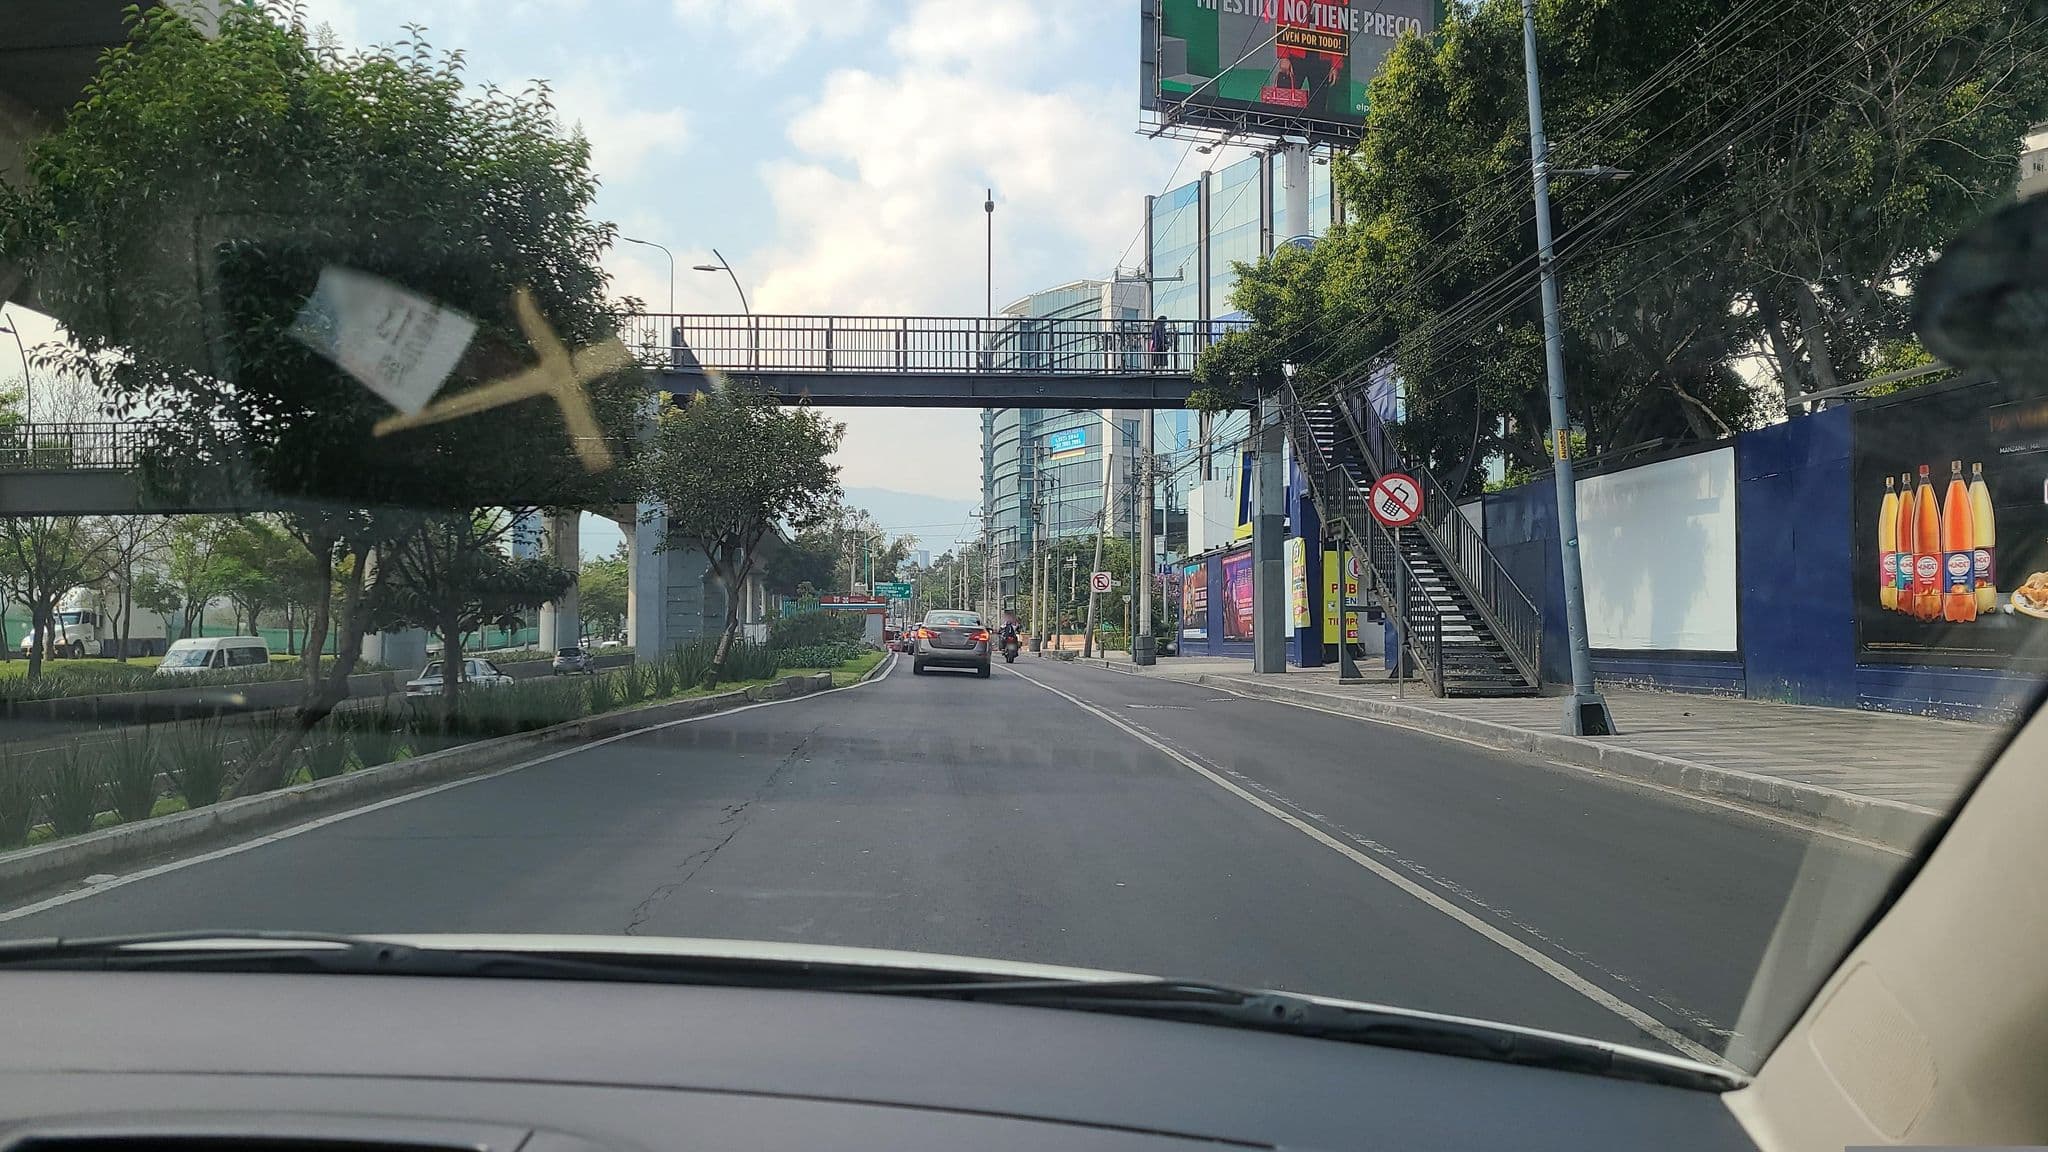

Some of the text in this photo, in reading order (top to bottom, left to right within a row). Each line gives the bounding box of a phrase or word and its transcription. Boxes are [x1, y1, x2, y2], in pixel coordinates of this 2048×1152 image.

[1283, 0, 1308, 23] NO
[1311, 3, 1359, 32] TIENE
[1302, 33, 1317, 45] POR
[1318, 36, 1341, 49] TODO!
